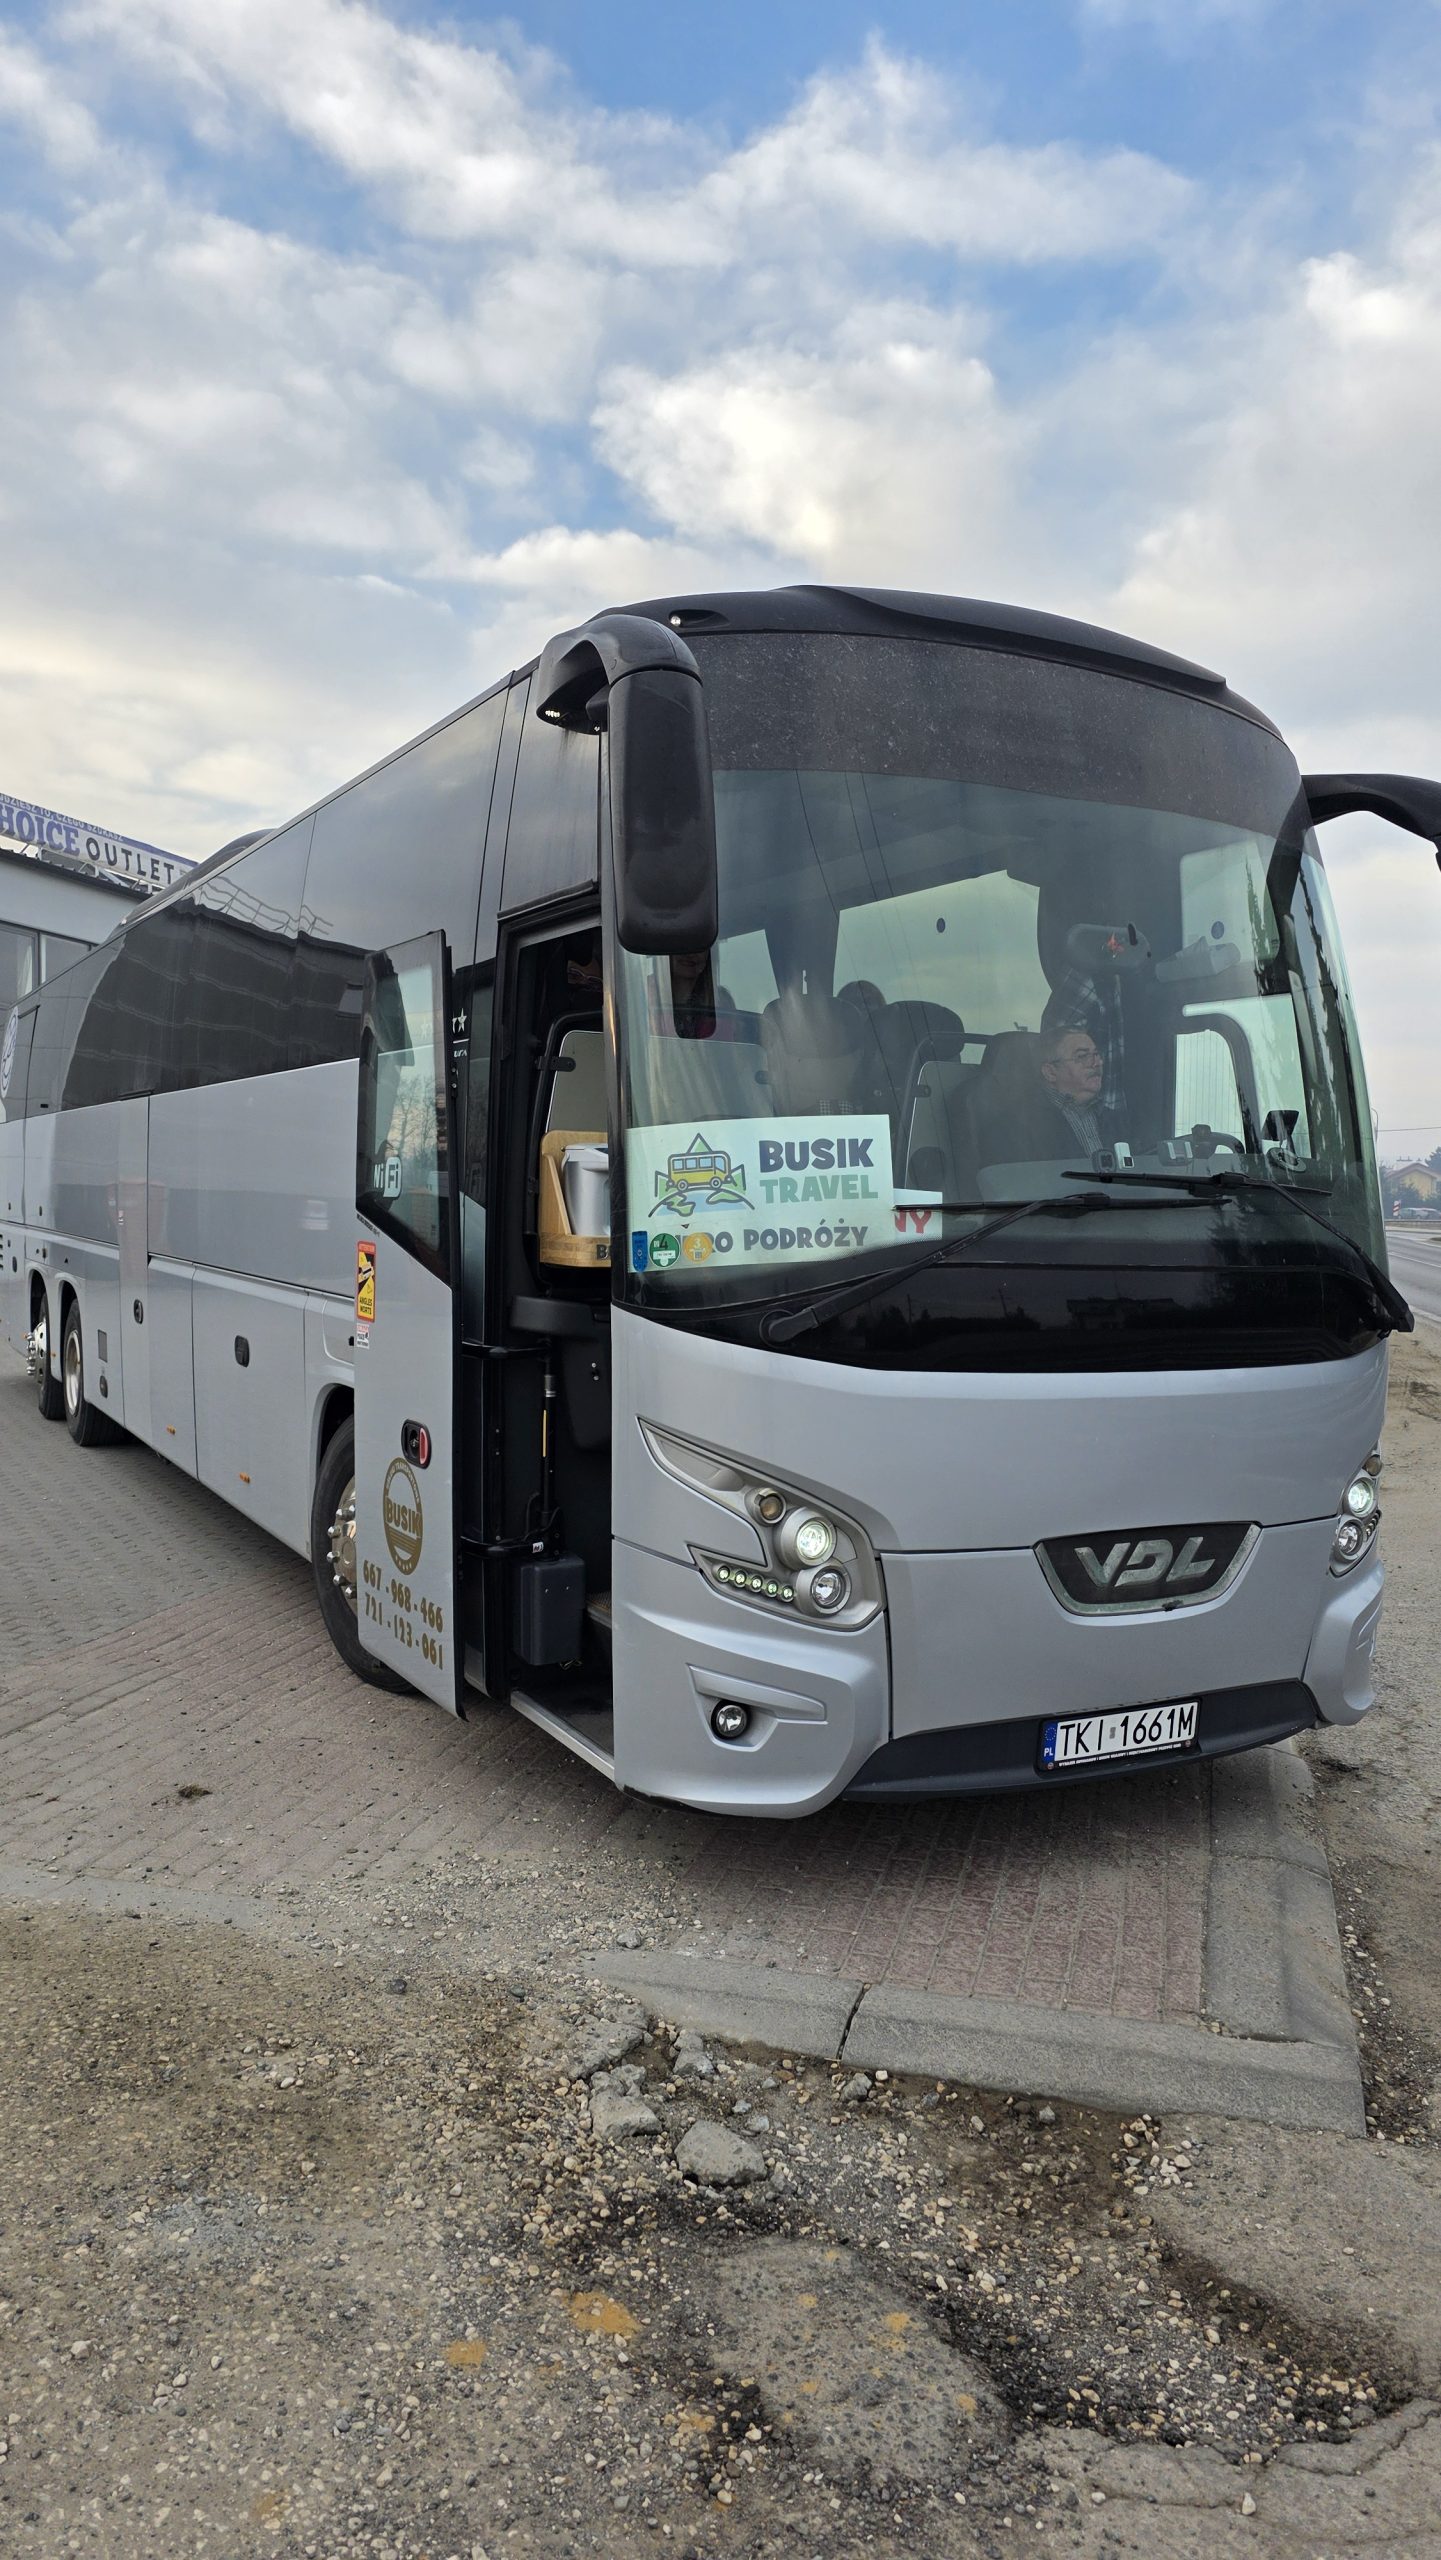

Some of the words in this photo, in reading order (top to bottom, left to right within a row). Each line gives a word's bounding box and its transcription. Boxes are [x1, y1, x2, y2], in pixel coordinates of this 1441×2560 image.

[86, 837, 174, 885] OUTLET
[759, 1138, 874, 1173] BUSIK
[760, 1173, 879, 1204] TRAVEL
[659, 1235, 669, 1251] 4
[744, 1218, 869, 1252] PODRÓŻY
[386, 1496, 421, 1538] BUSIK
[1074, 1536, 1216, 1588] VDL
[363, 1559, 382, 1591] 667
[391, 1578, 411, 1613] 968
[420, 1597, 443, 1633] 466
[365, 1591, 382, 1626] 721
[394, 1614, 412, 1648] 123
[422, 1633, 443, 1671] 061
[1044, 1747, 1054, 1757] PL
[1060, 1719, 1104, 1757] TKI
[1120, 1705, 1195, 1747] 1661M
